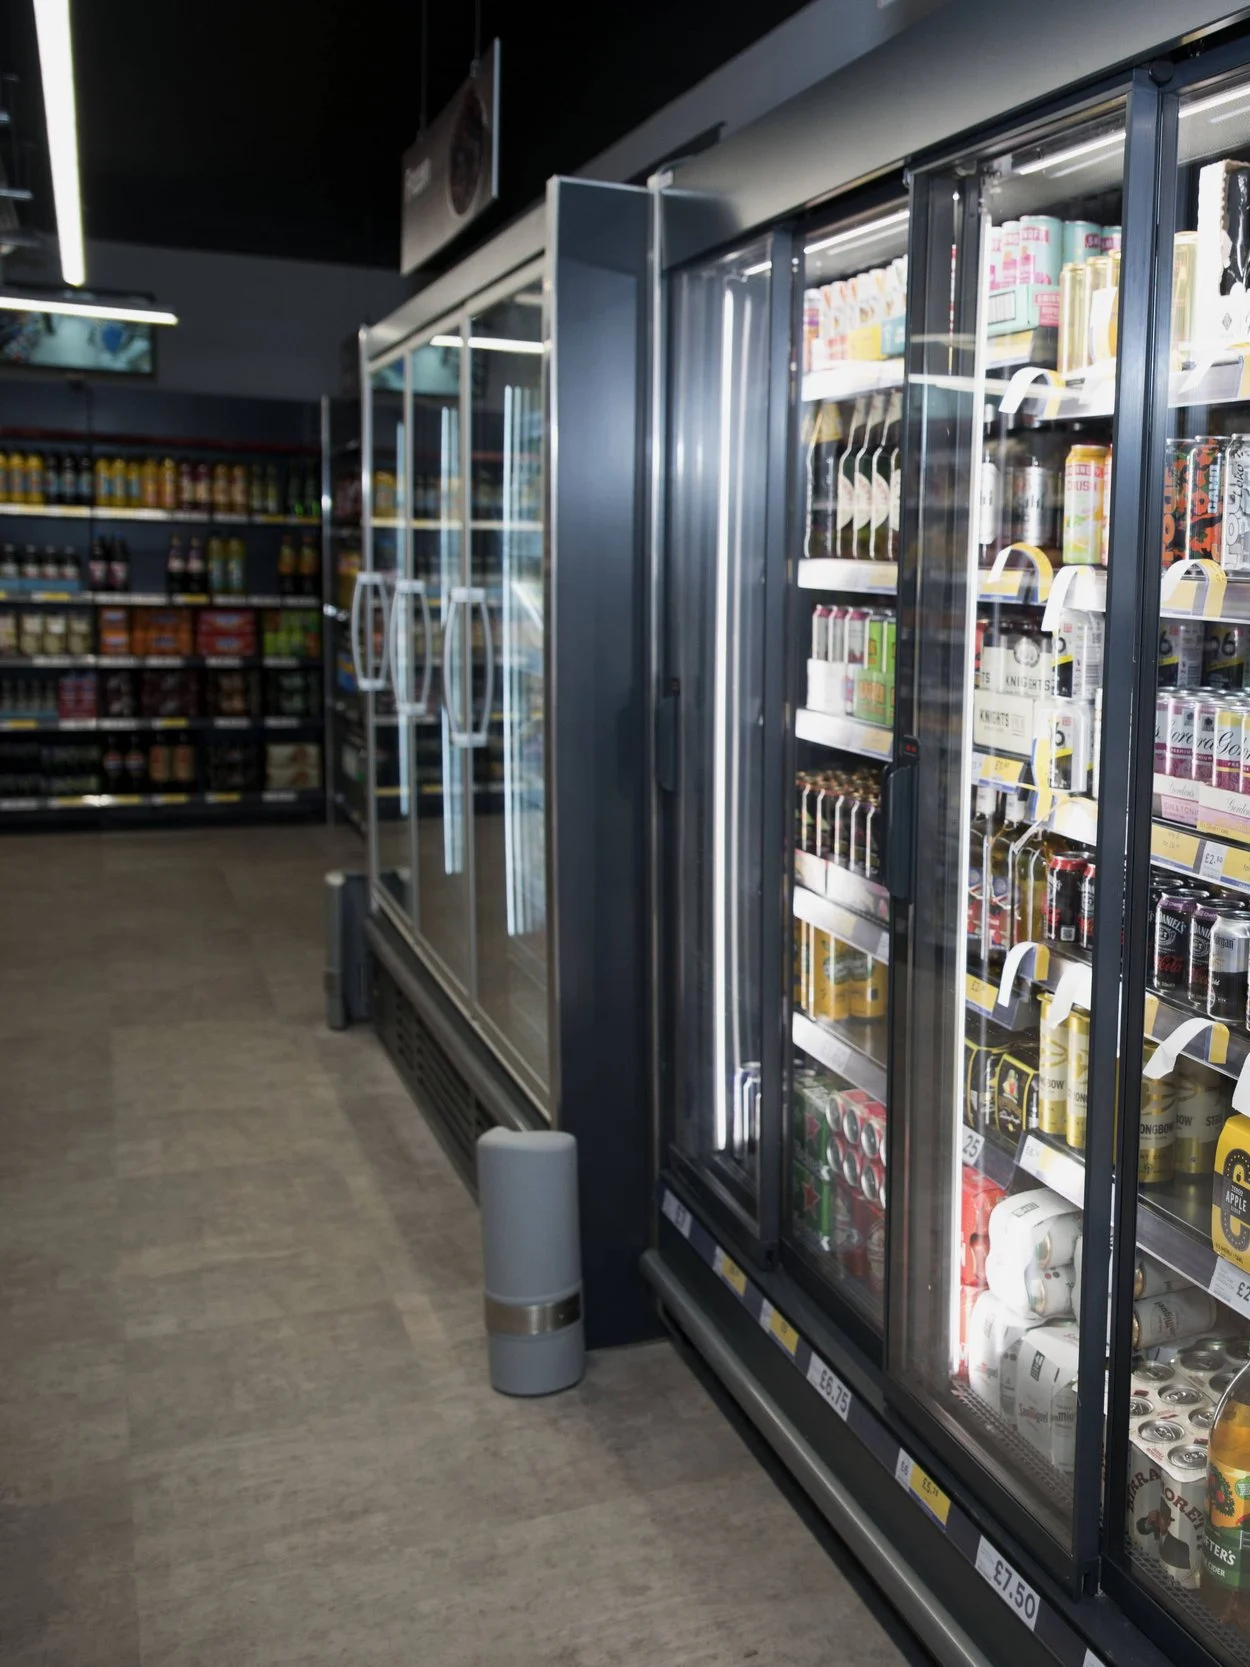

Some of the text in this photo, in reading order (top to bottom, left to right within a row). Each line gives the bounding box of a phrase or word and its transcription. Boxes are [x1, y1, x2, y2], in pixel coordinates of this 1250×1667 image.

[1205, 853, 1223, 865] £2.50
[1225, 1190, 1247, 1213] APPLE
[820, 1369, 850, 1415] £6.75
[1203, 1534, 1236, 1567] FTER'S
[992, 1559, 1037, 1620] £7.50
